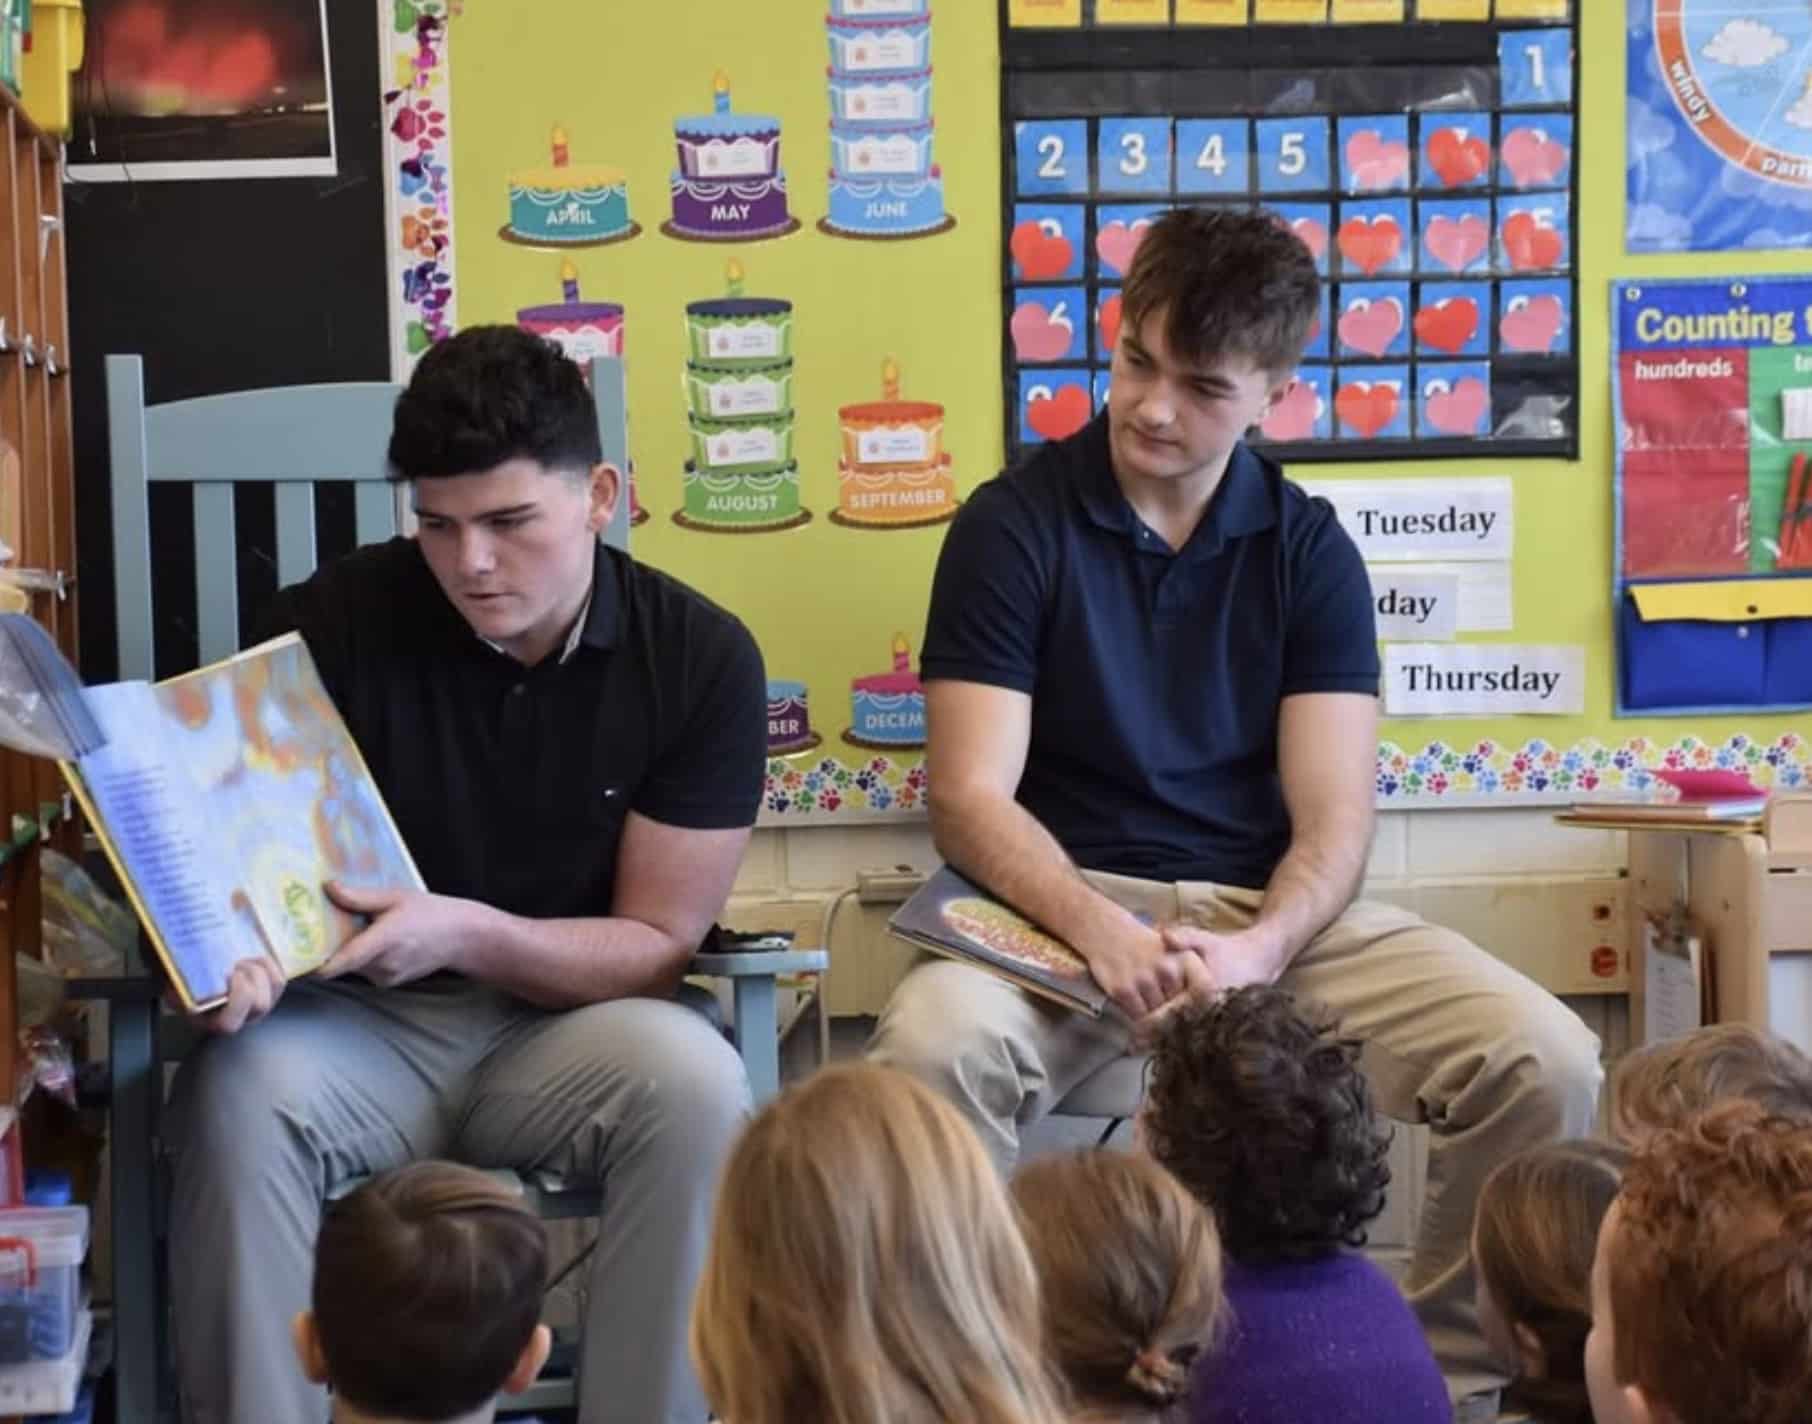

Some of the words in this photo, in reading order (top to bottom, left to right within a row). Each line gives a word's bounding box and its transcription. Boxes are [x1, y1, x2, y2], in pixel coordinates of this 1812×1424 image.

[1524, 44, 1545, 89] 1
[1670, 60, 1712, 123] windy
[1036, 135, 1067, 179] 2
[1119, 133, 1147, 176] 3
[1197, 133, 1227, 176] 4
[1278, 132, 1307, 175] 5
[545, 207, 597, 226] APRIL
[711, 203, 753, 222] MAY
[864, 202, 908, 219] JUNE
[1635, 307, 1795, 344] Counting
[1634, 359, 1734, 381] hundreds
[705, 494, 779, 513] AUGUST
[849, 488, 946, 510] SEPTEMBER
[1356, 506, 1496, 538] Tuesday
[1377, 588, 1437, 623] day
[1401, 664, 1561, 699] Thursday
[768, 719, 800, 735] BER
[864, 713, 924, 729] DECEM
